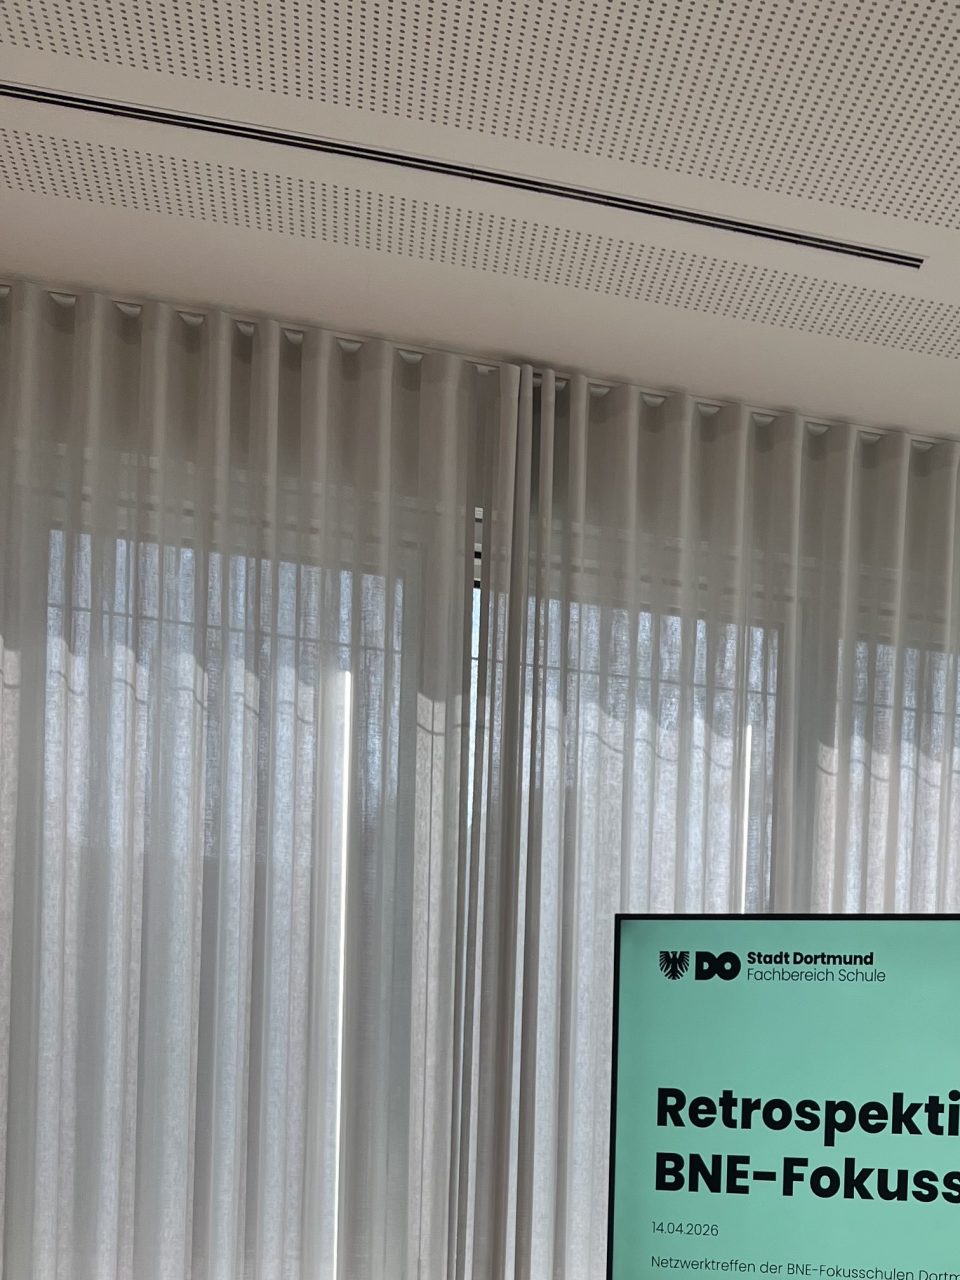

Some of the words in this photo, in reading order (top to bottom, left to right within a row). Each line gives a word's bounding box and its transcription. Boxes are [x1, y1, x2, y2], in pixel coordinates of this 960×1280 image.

[694, 951, 742, 981] DO
[747, 951, 790, 965] Stadt
[793, 952, 874, 966] Dortmund
[747, 968, 835, 983] Fachbereich
[838, 968, 887, 983] Schule
[651, 1221, 719, 1237] 14.04.2026
[651, 1256, 756, 1273] Netzwerktreffen
[760, 1261, 783, 1275] der
